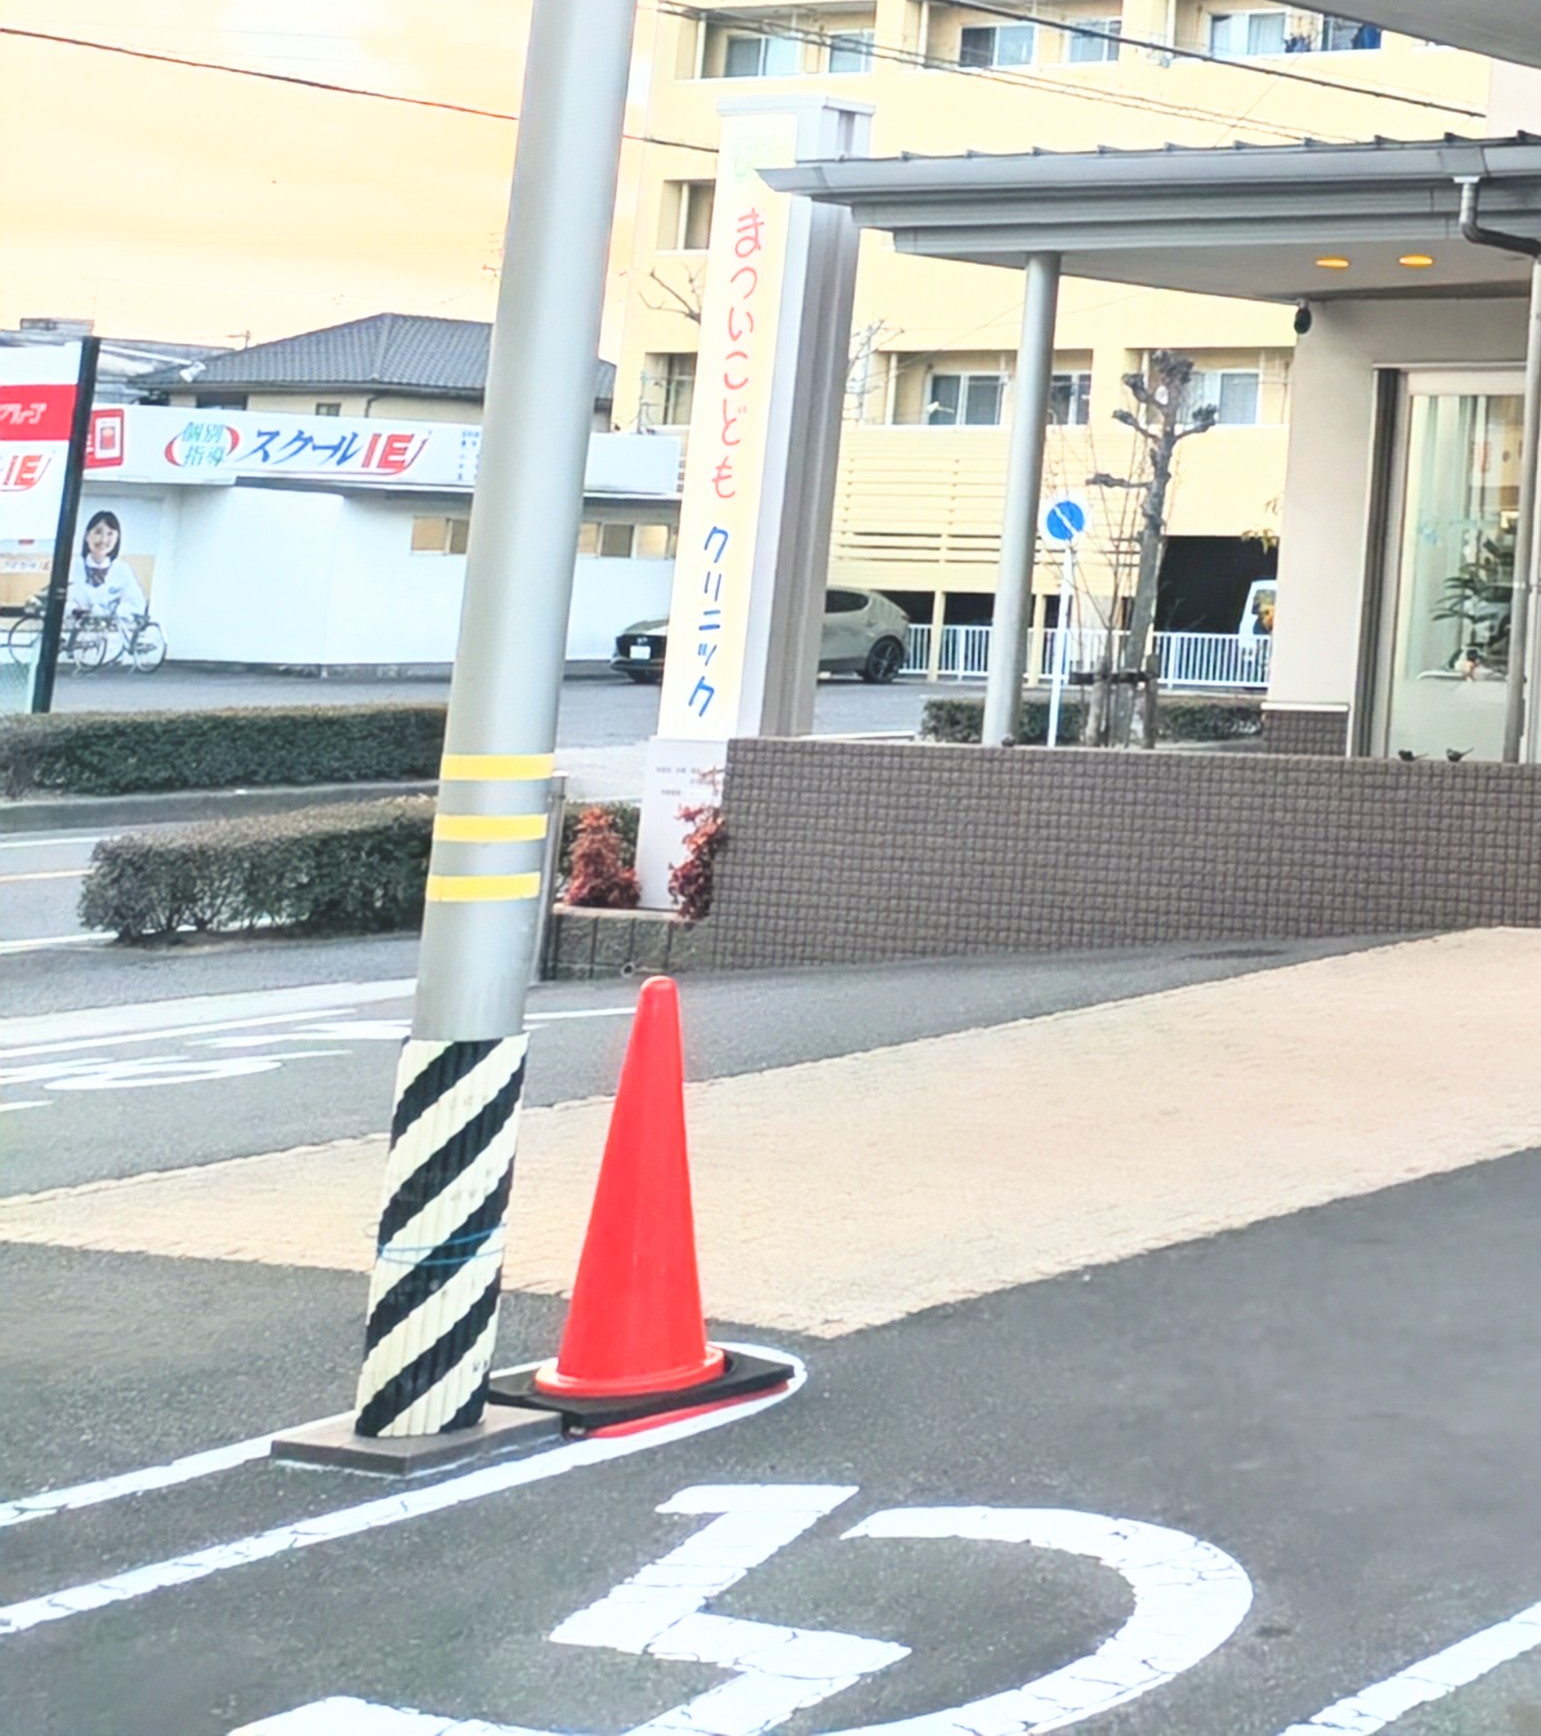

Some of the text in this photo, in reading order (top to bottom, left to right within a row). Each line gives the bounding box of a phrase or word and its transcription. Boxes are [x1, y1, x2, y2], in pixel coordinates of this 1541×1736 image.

[688, 207, 765, 717] まついこども クリニック
